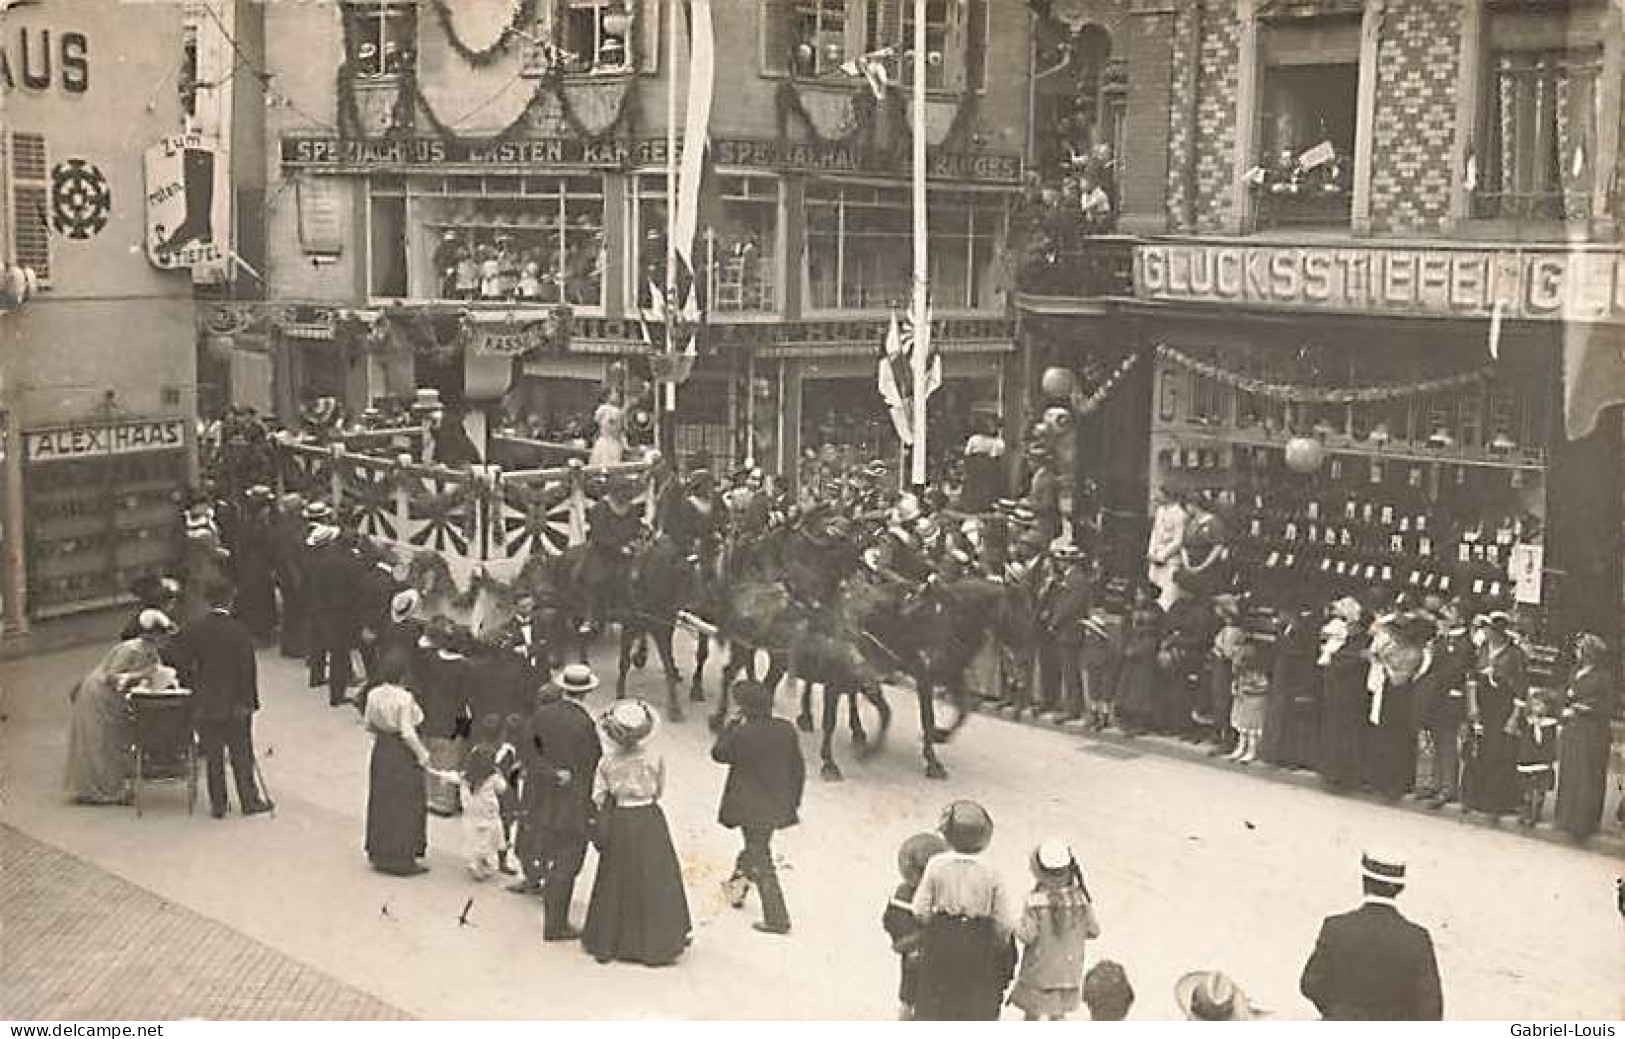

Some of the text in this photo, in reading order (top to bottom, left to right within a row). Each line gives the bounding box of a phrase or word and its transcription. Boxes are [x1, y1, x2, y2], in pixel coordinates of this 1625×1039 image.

[298, 141, 445, 161] SPEIALHUS
[37, 424, 177, 457] ALEX HAAS
